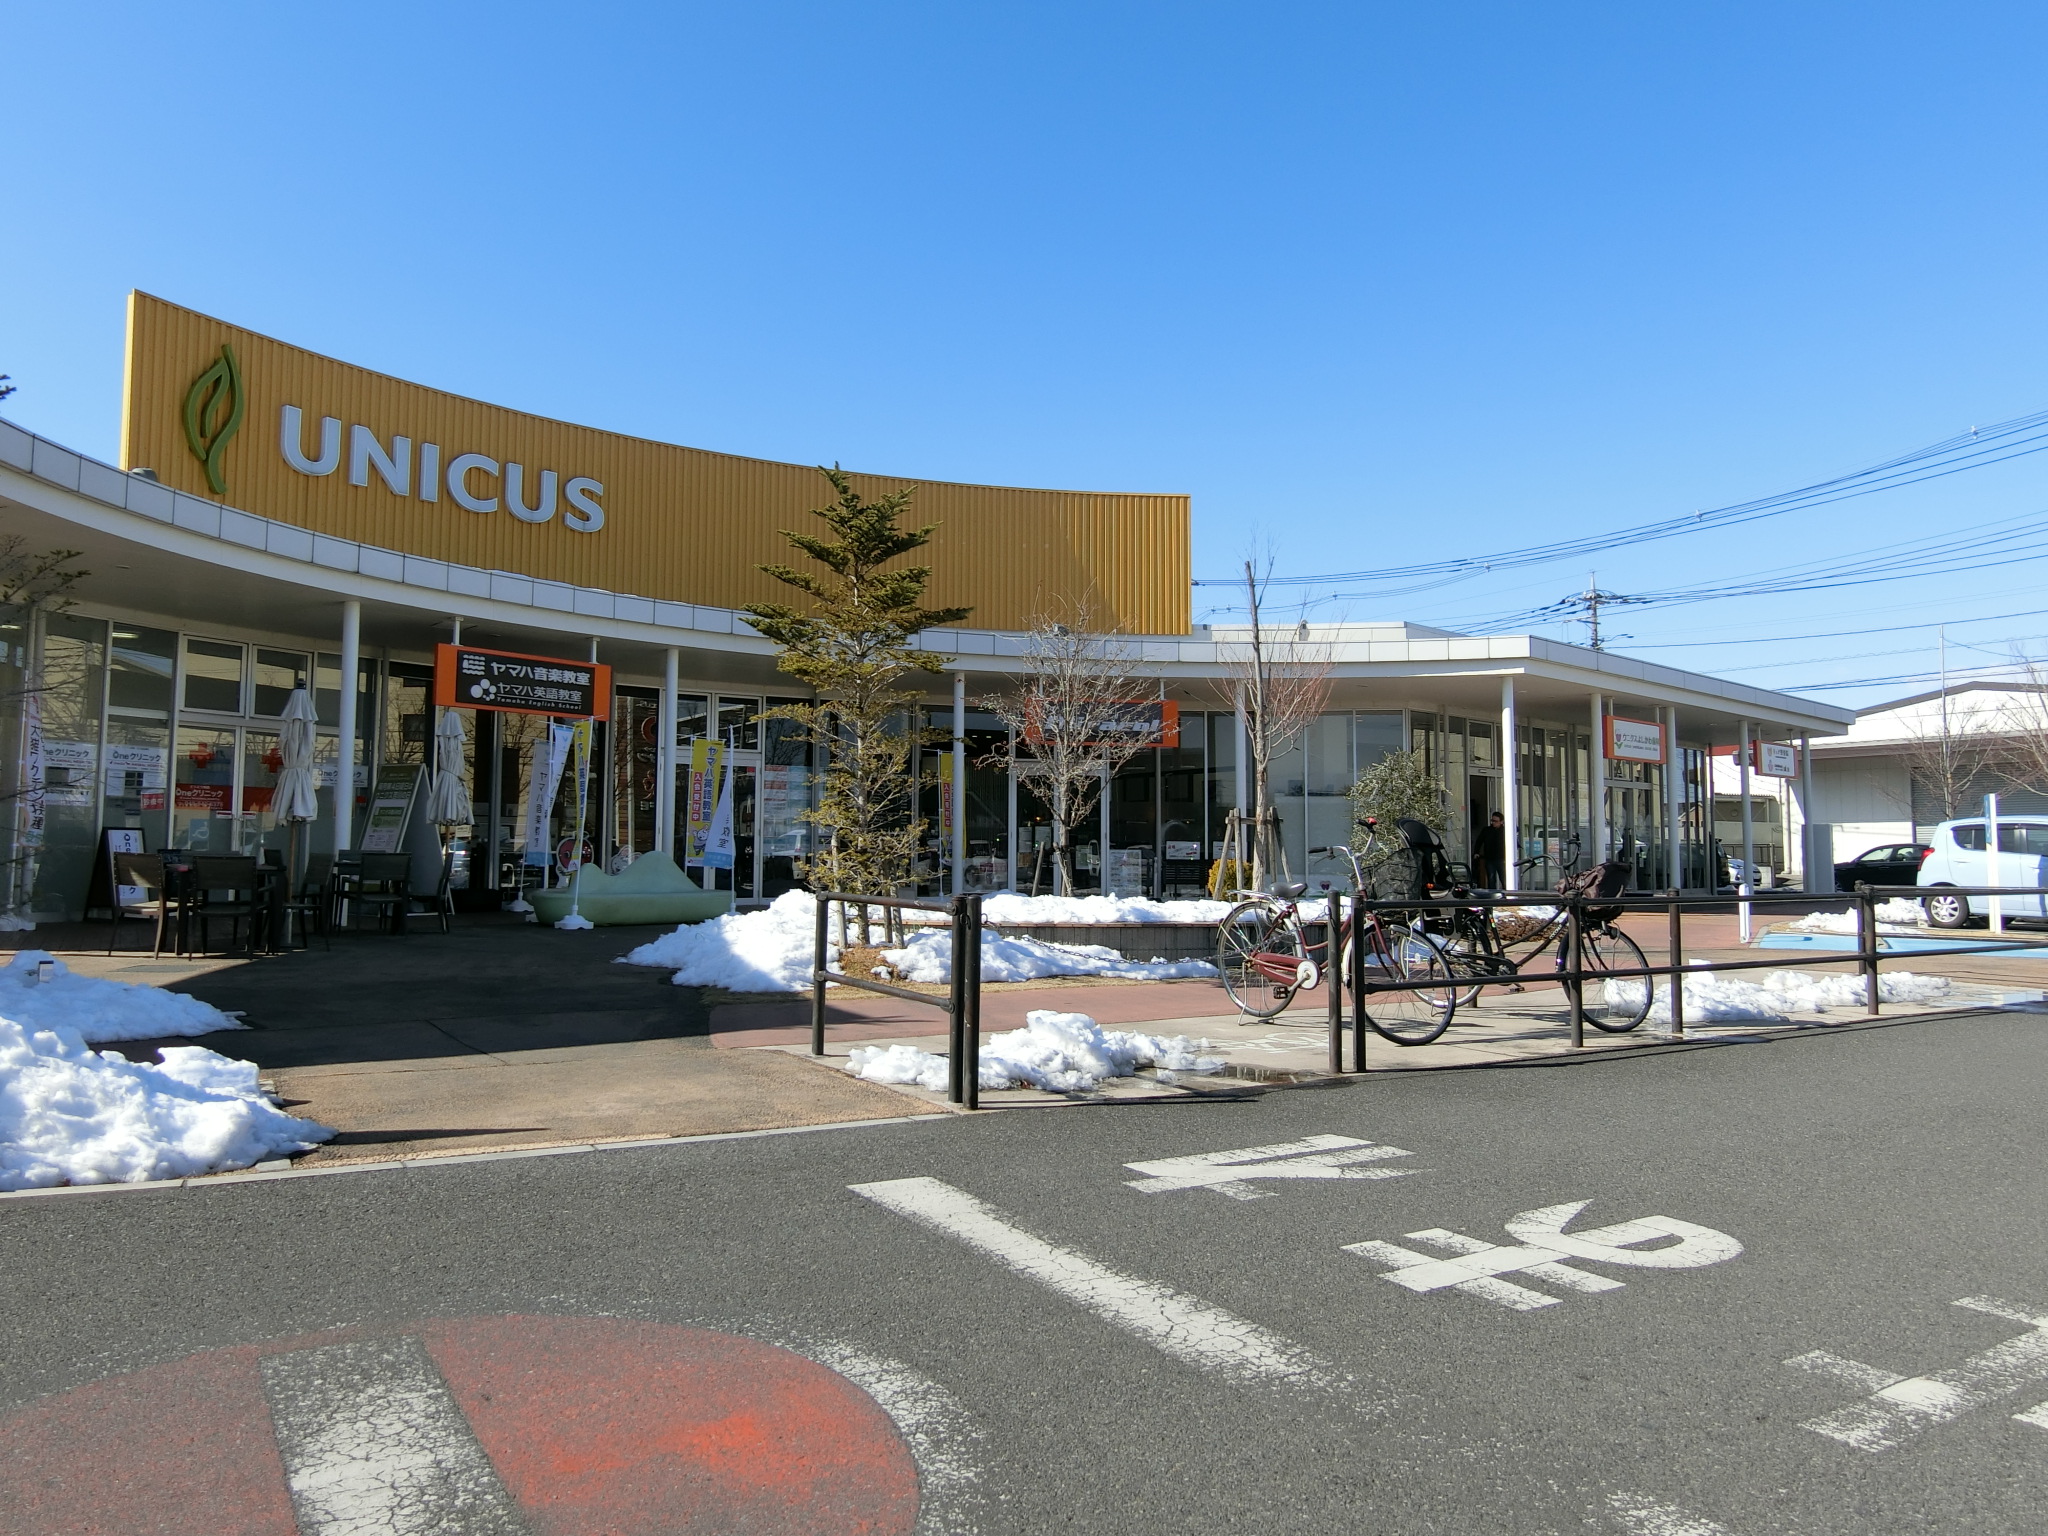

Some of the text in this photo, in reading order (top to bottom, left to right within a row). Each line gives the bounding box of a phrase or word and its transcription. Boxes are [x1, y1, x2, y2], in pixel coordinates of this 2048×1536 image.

[280, 404, 606, 533] UNICUS
[491, 662, 591, 686] ヤマハ音楽教室
[497, 681, 582, 702] ヤマハ英語教室
[497, 697, 525, 705] Yamaha
[528, 700, 555, 708] English
[692, 772, 702, 821] 入会受付中
[701, 746, 718, 822] ヤマハ英語教室
